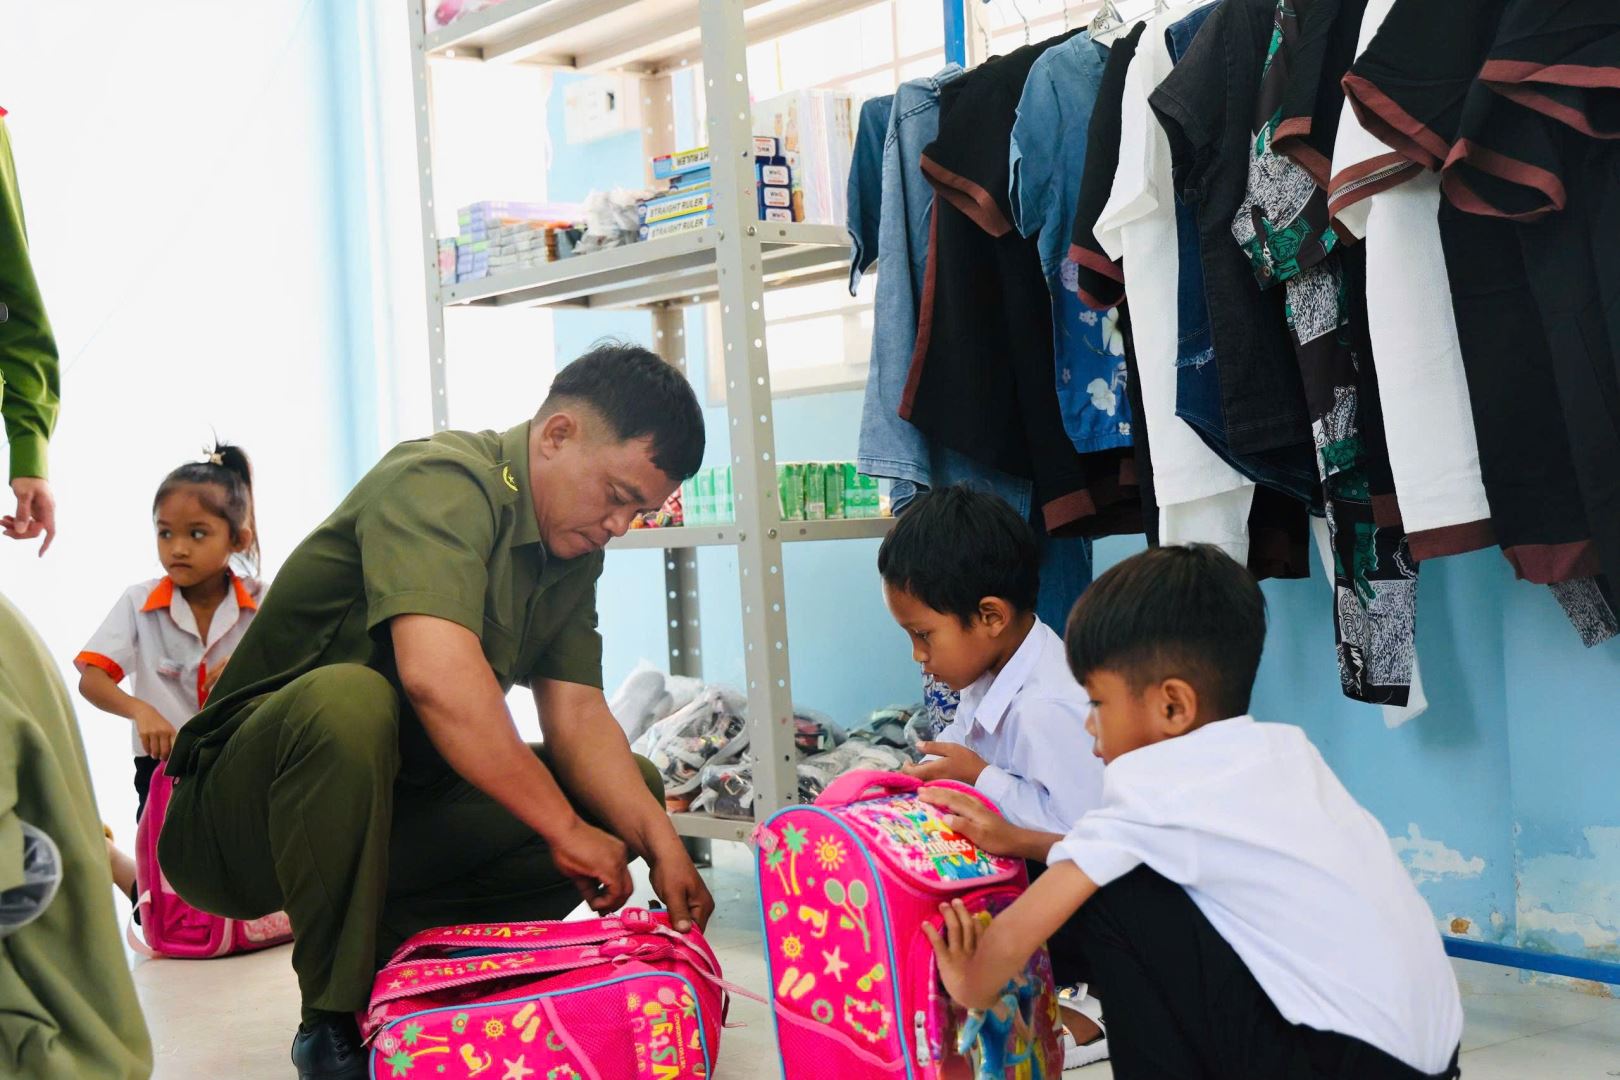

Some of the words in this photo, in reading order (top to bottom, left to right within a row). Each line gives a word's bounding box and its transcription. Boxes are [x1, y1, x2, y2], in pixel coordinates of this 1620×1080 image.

[650, 202, 681, 217] STRAIGHT
[682, 197, 704, 210] RULER
[652, 222, 681, 238] STRAIGHT
[682, 217, 704, 230] RULER
